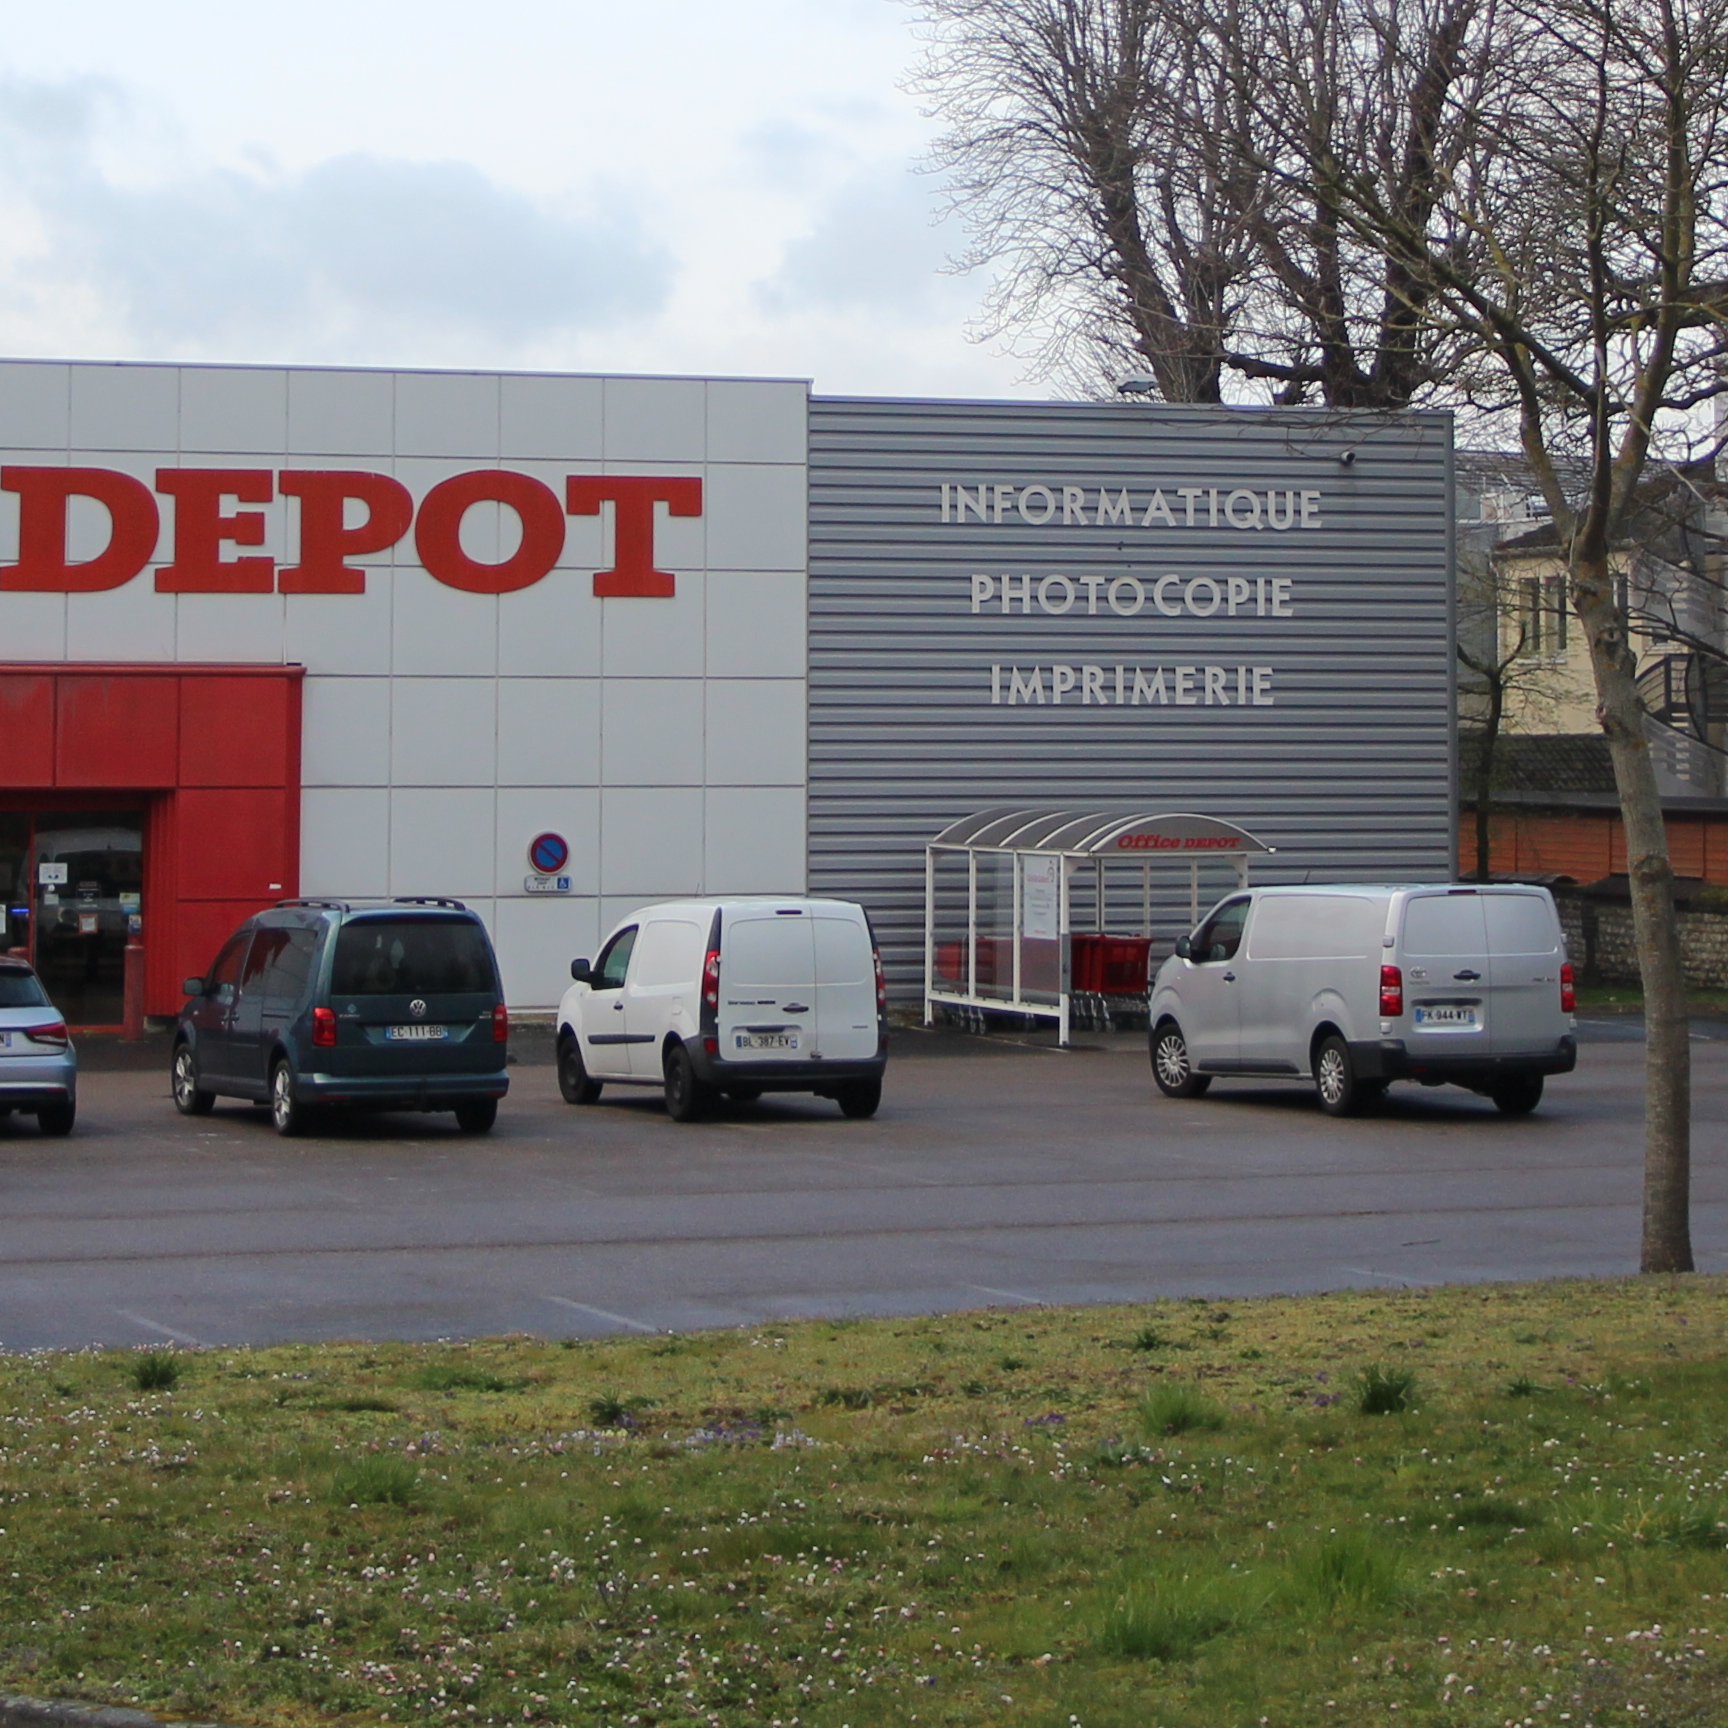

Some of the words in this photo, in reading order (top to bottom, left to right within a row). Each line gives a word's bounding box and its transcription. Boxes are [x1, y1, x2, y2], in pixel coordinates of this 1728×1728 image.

[940, 482, 1323, 532] INFORMATIQUE
[971, 573, 1294, 618] PHOTOCOPIE
[990, 663, 1275, 707] IMPRIMERIE
[1117, 834, 1182, 849] Office
[1183, 837, 1242, 848] DEPOT
